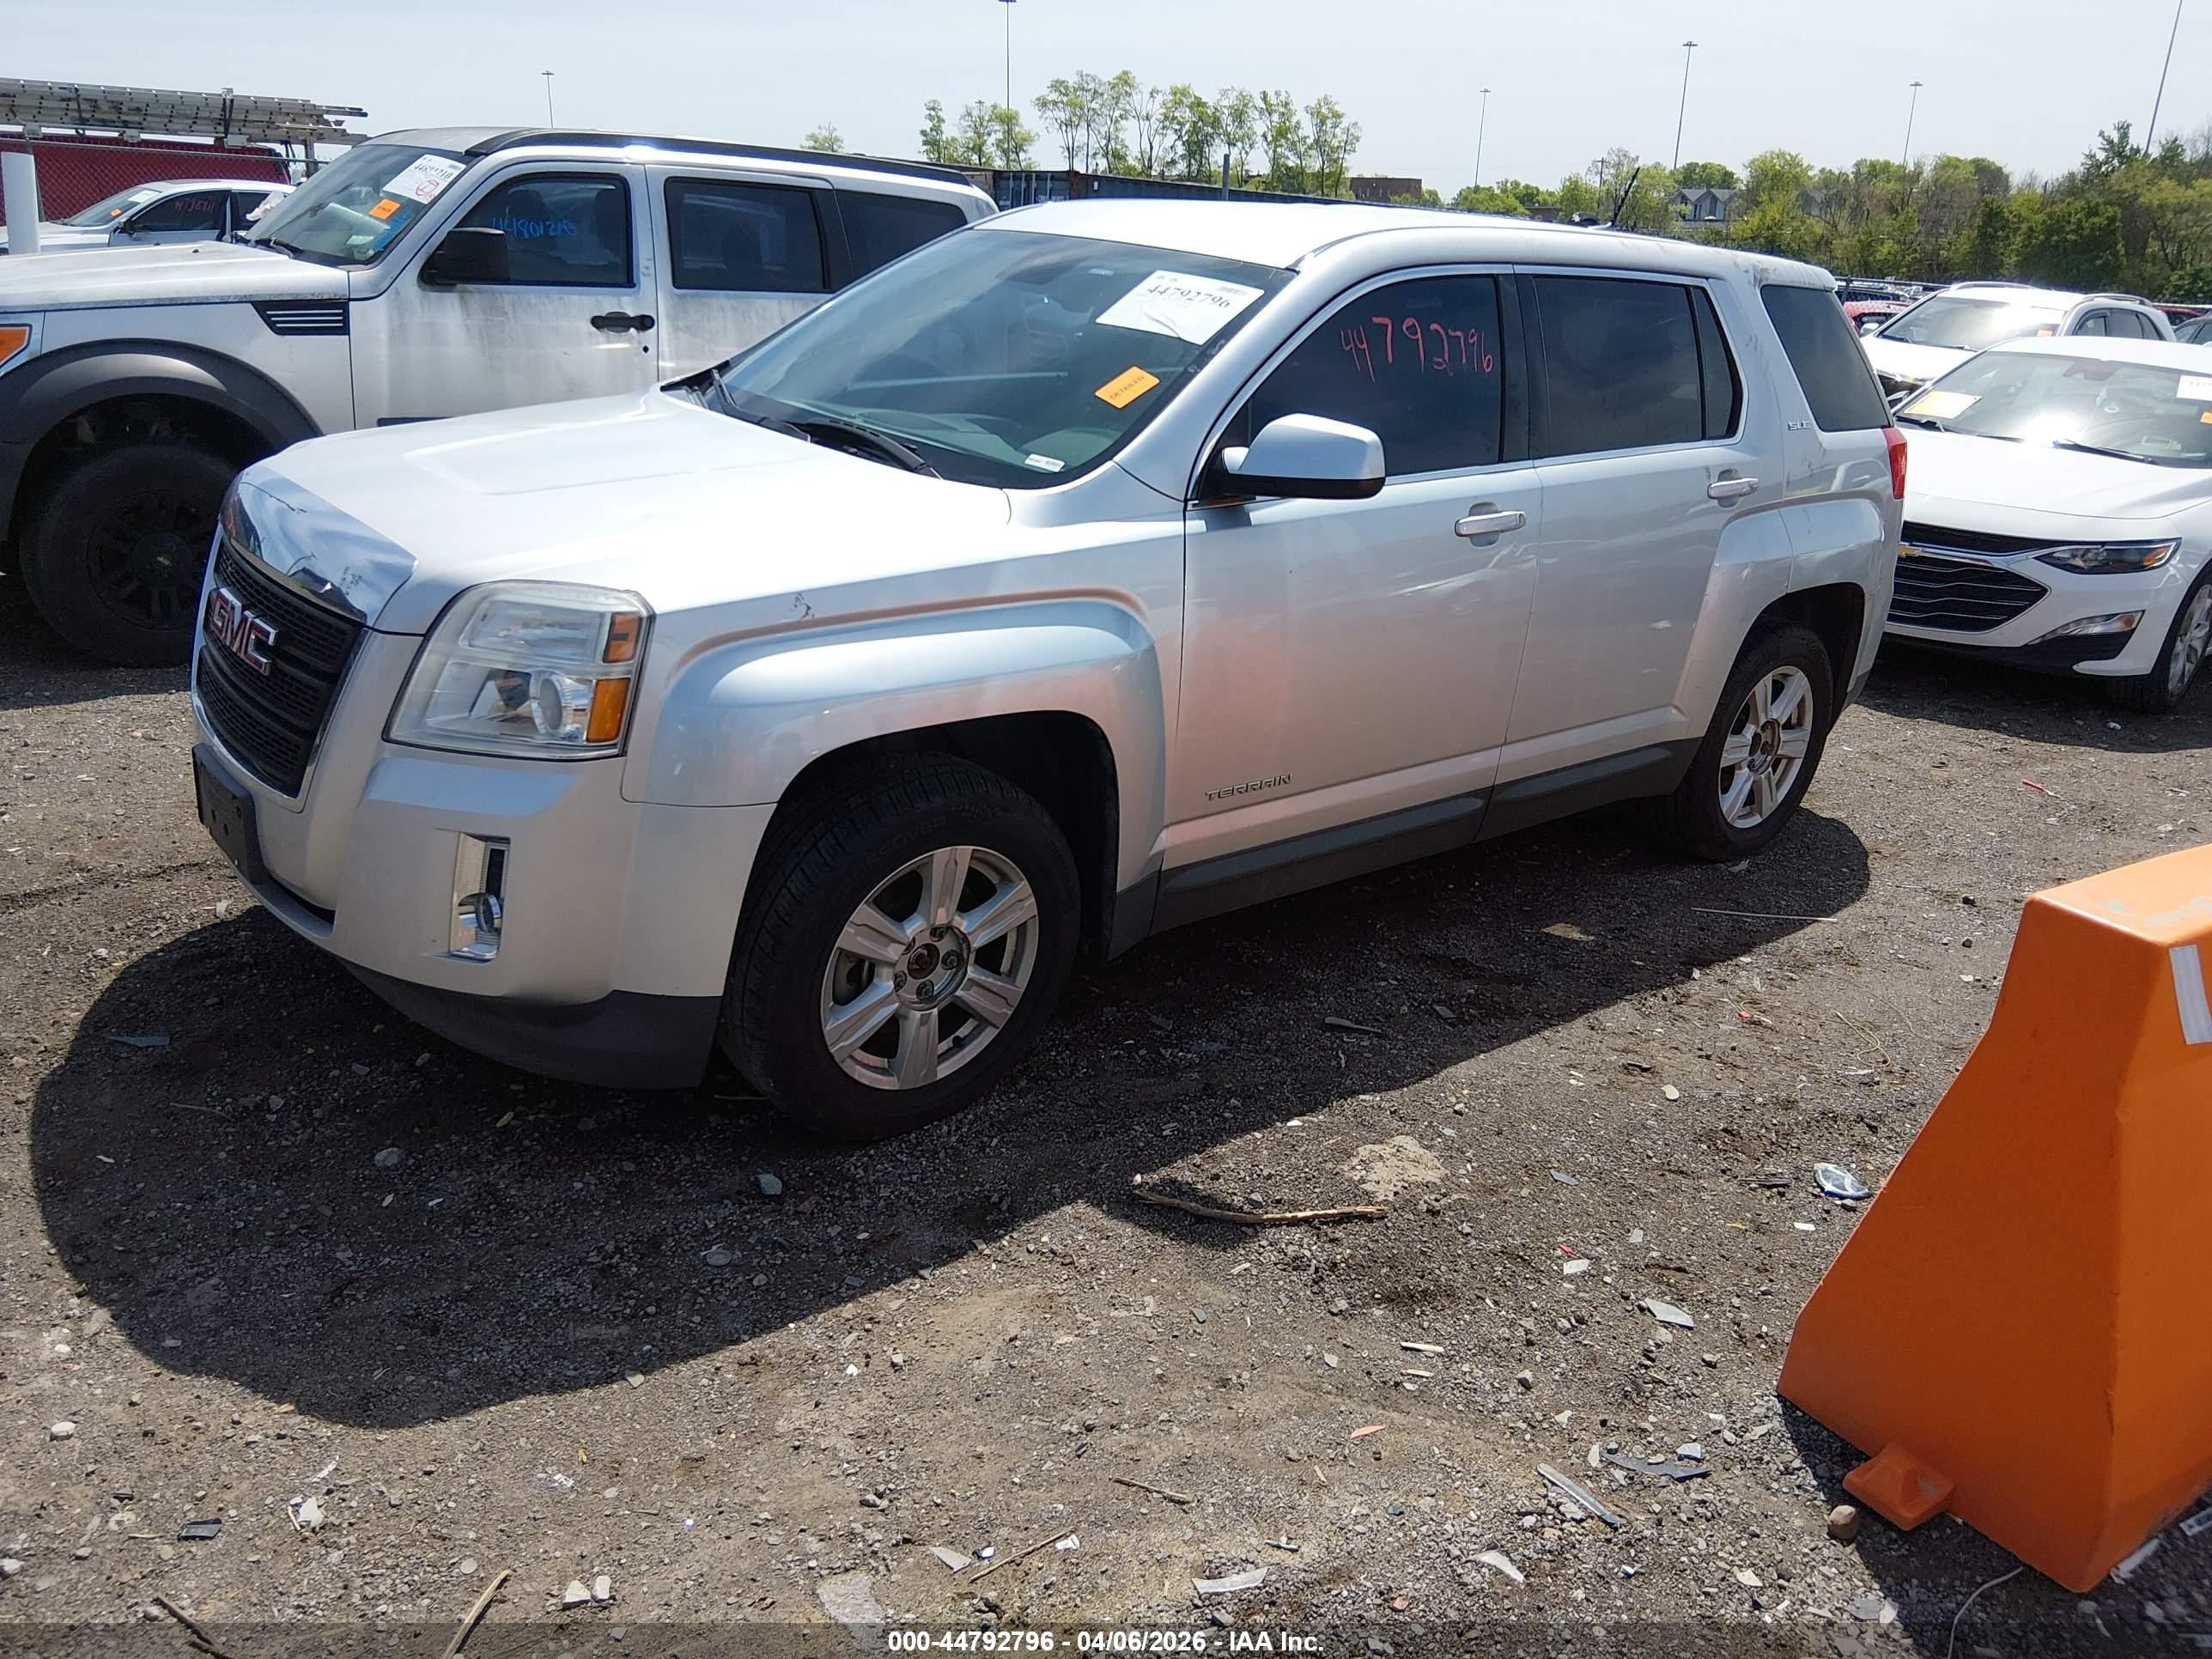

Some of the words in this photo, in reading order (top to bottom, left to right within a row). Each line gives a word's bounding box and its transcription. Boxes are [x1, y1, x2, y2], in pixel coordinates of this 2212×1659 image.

[1146, 284, 1231, 309] 44792796
[1340, 315, 1494, 384] 44792796
[1787, 420, 1811, 431] SLE
[207, 587, 278, 676] GMC
[1204, 774, 1292, 800] TERRAIN
